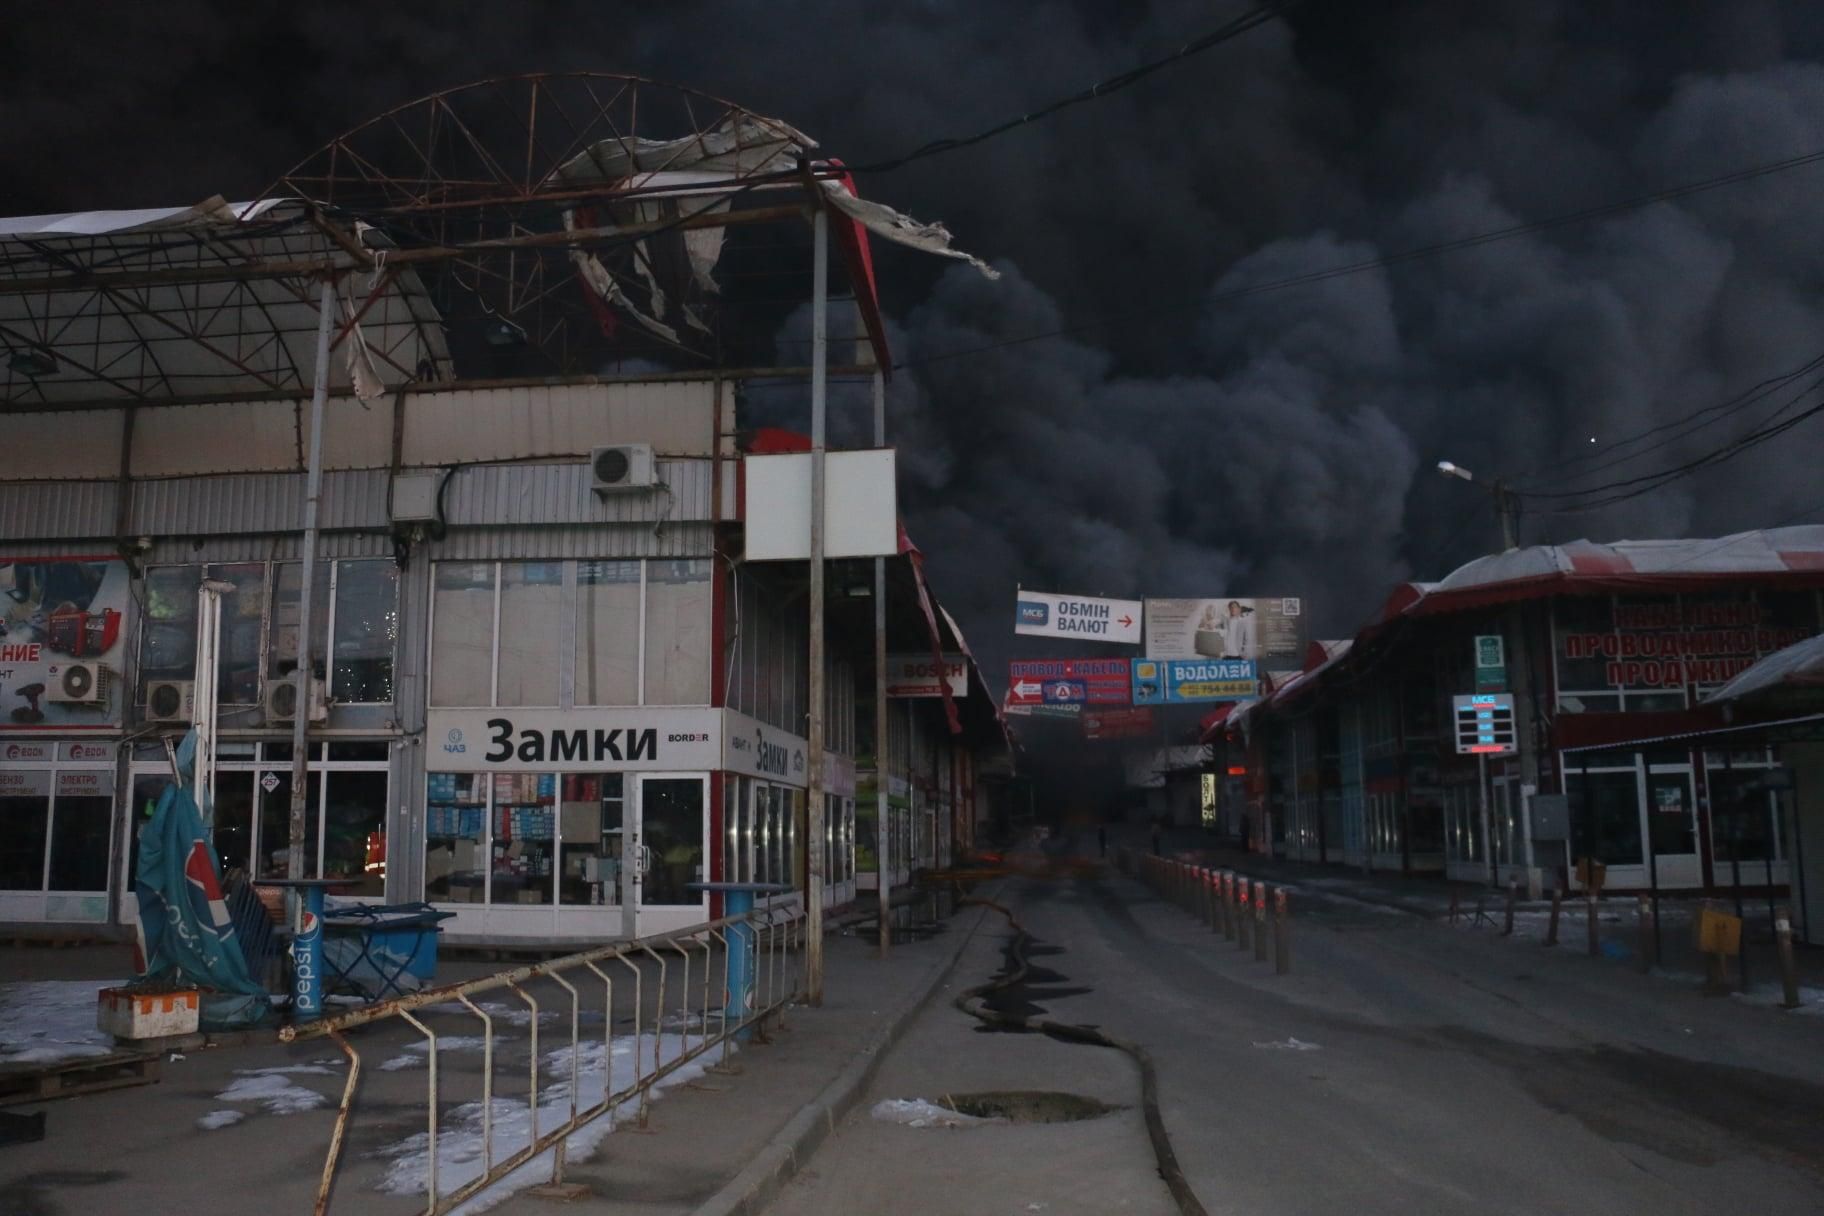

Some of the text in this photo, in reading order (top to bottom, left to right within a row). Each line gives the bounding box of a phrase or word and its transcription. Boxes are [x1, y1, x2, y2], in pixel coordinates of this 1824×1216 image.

[1022, 608, 1044, 618] МСБ
[1058, 602, 1109, 618] ОБМІН
[1057, 617, 1108, 634] ВАЛЮТ
[0, 644, 40, 662] НИЕ
[1012, 662, 1127, 677] ПРОВОД КАБЕЛЬ
[485, 718, 657, 763] Замки
[668, 733, 709, 742] BORDER
[444, 743, 466, 753] ЧАЗ
[756, 727, 788, 776] Замки
[61, 775, 97, 785] ЭЛЕКТРО
[295, 946, 316, 1010] pepsi
